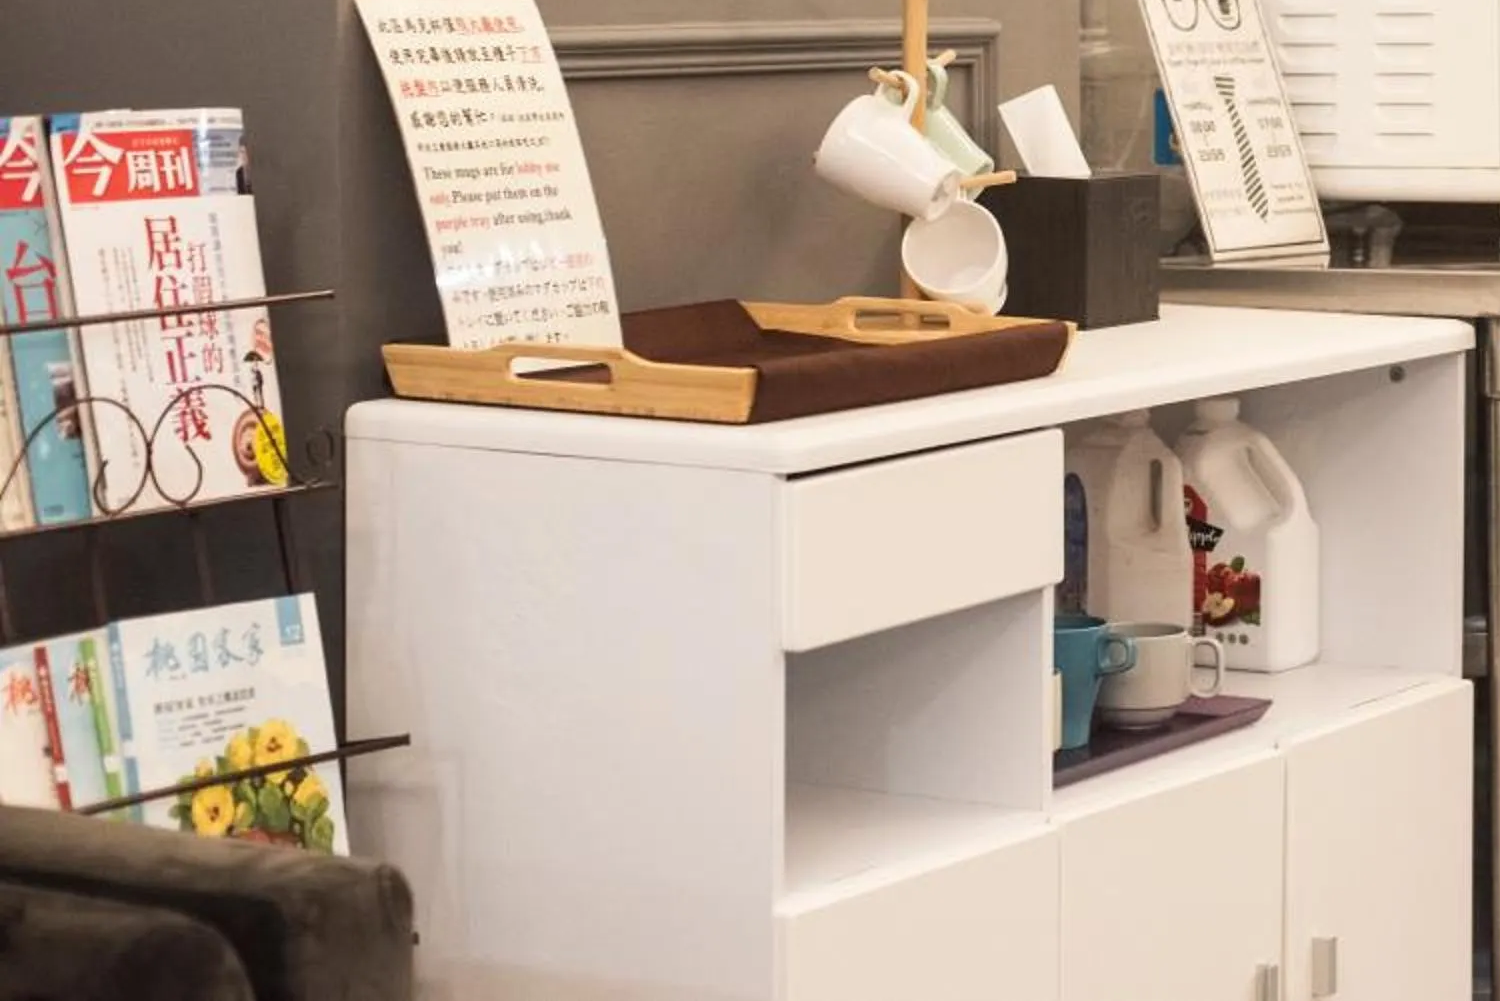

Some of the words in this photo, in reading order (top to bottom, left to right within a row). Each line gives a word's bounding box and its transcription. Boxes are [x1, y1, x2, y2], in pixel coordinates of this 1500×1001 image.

[63, 116, 194, 198] 今周刊
[424, 166, 451, 179] These
[455, 167, 480, 179] mugs
[483, 166, 499, 176] are
[486, 189, 502, 204] put
[543, 186, 559, 197] the
[144, 215, 211, 441] 居住正義
